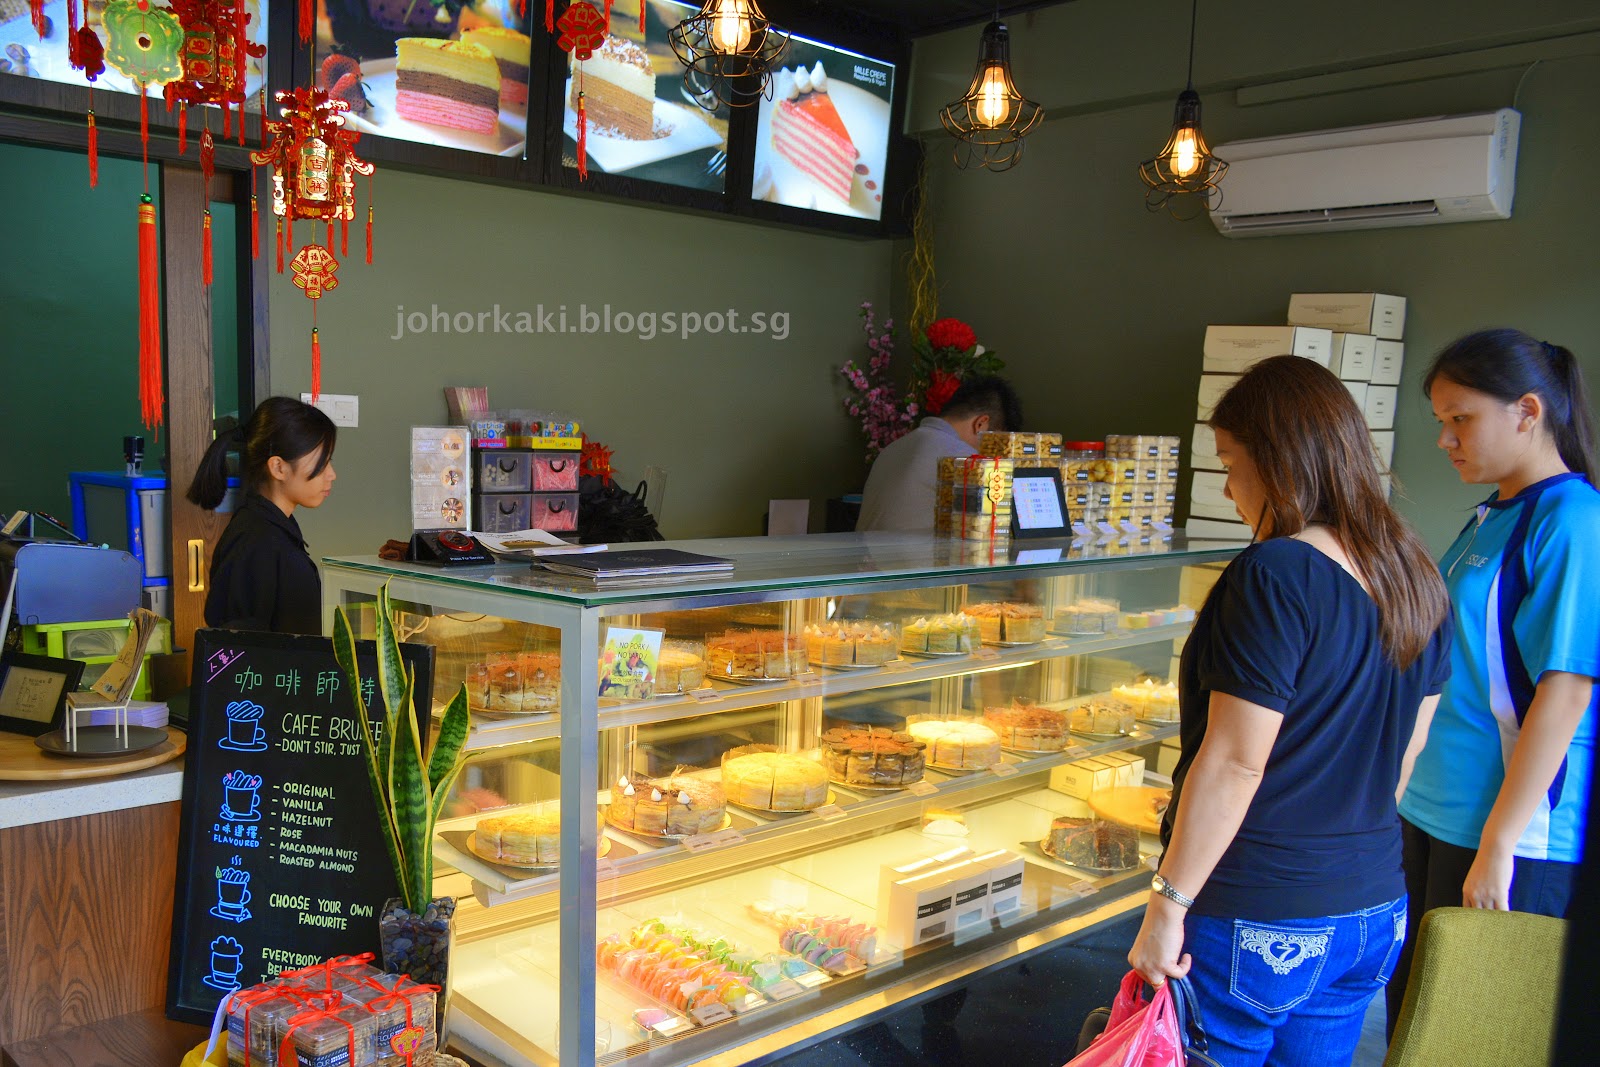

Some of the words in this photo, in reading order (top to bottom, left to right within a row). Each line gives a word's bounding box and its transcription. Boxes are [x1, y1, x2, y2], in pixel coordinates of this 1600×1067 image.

[281, 712, 322, 737] CAFE
[339, 742, 361, 756] JUST
[283, 782, 335, 800] ORIGINAL
[282, 797, 324, 812] VANILLA
[281, 811, 333, 828] HAZELNUT
[213, 833, 260, 848] FLAVOURED
[279, 826, 302, 840] ROSE
[279, 841, 334, 857] MACADAMIA
[335, 848, 358, 862] NUTS
[279, 854, 315, 868] ROASTED
[319, 860, 355, 874] ALMOND
[269, 893, 310, 911] CHOOSE
[317, 898, 341, 914] YOUR
[350, 903, 373, 918] OWN
[298, 912, 348, 930] FAVOURITE
[262, 947, 321, 966] EVERYBODY
